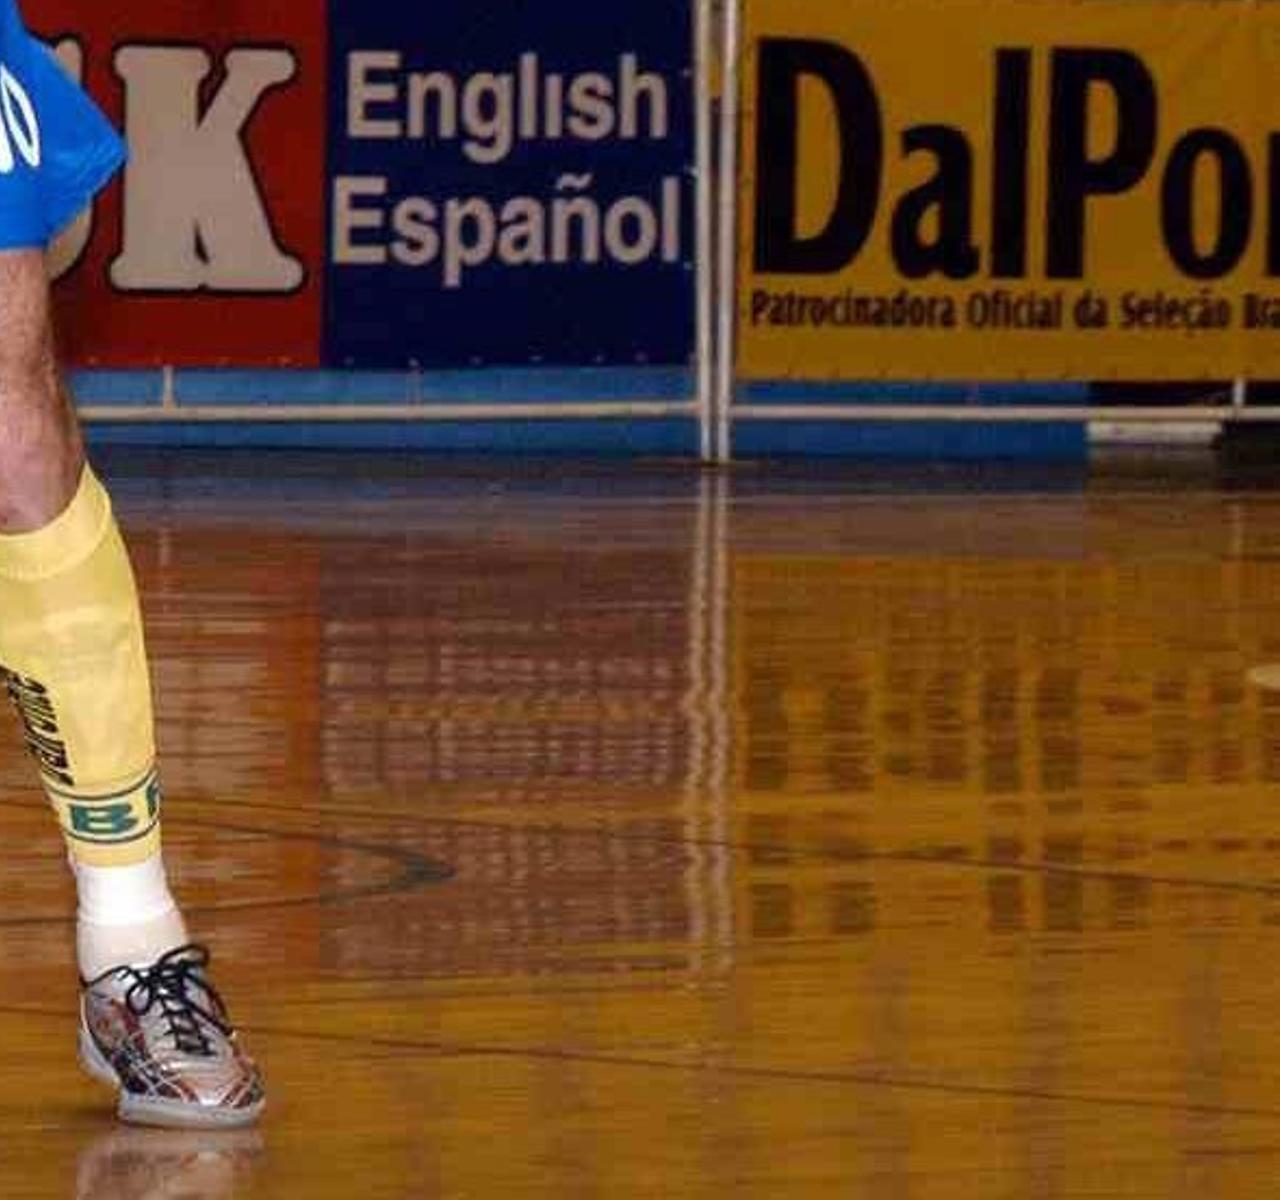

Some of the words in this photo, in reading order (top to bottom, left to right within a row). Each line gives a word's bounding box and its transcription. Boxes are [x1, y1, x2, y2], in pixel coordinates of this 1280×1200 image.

[347, 50, 667, 164] English
[752, 36, 1280, 281] DalPo
[332, 172, 679, 287] Español
[751, 288, 955, 328] Patrocinadora
[967, 289, 1062, 328] Oficial
[1073, 290, 1108, 329] da
[1121, 289, 1230, 338] Seleção
